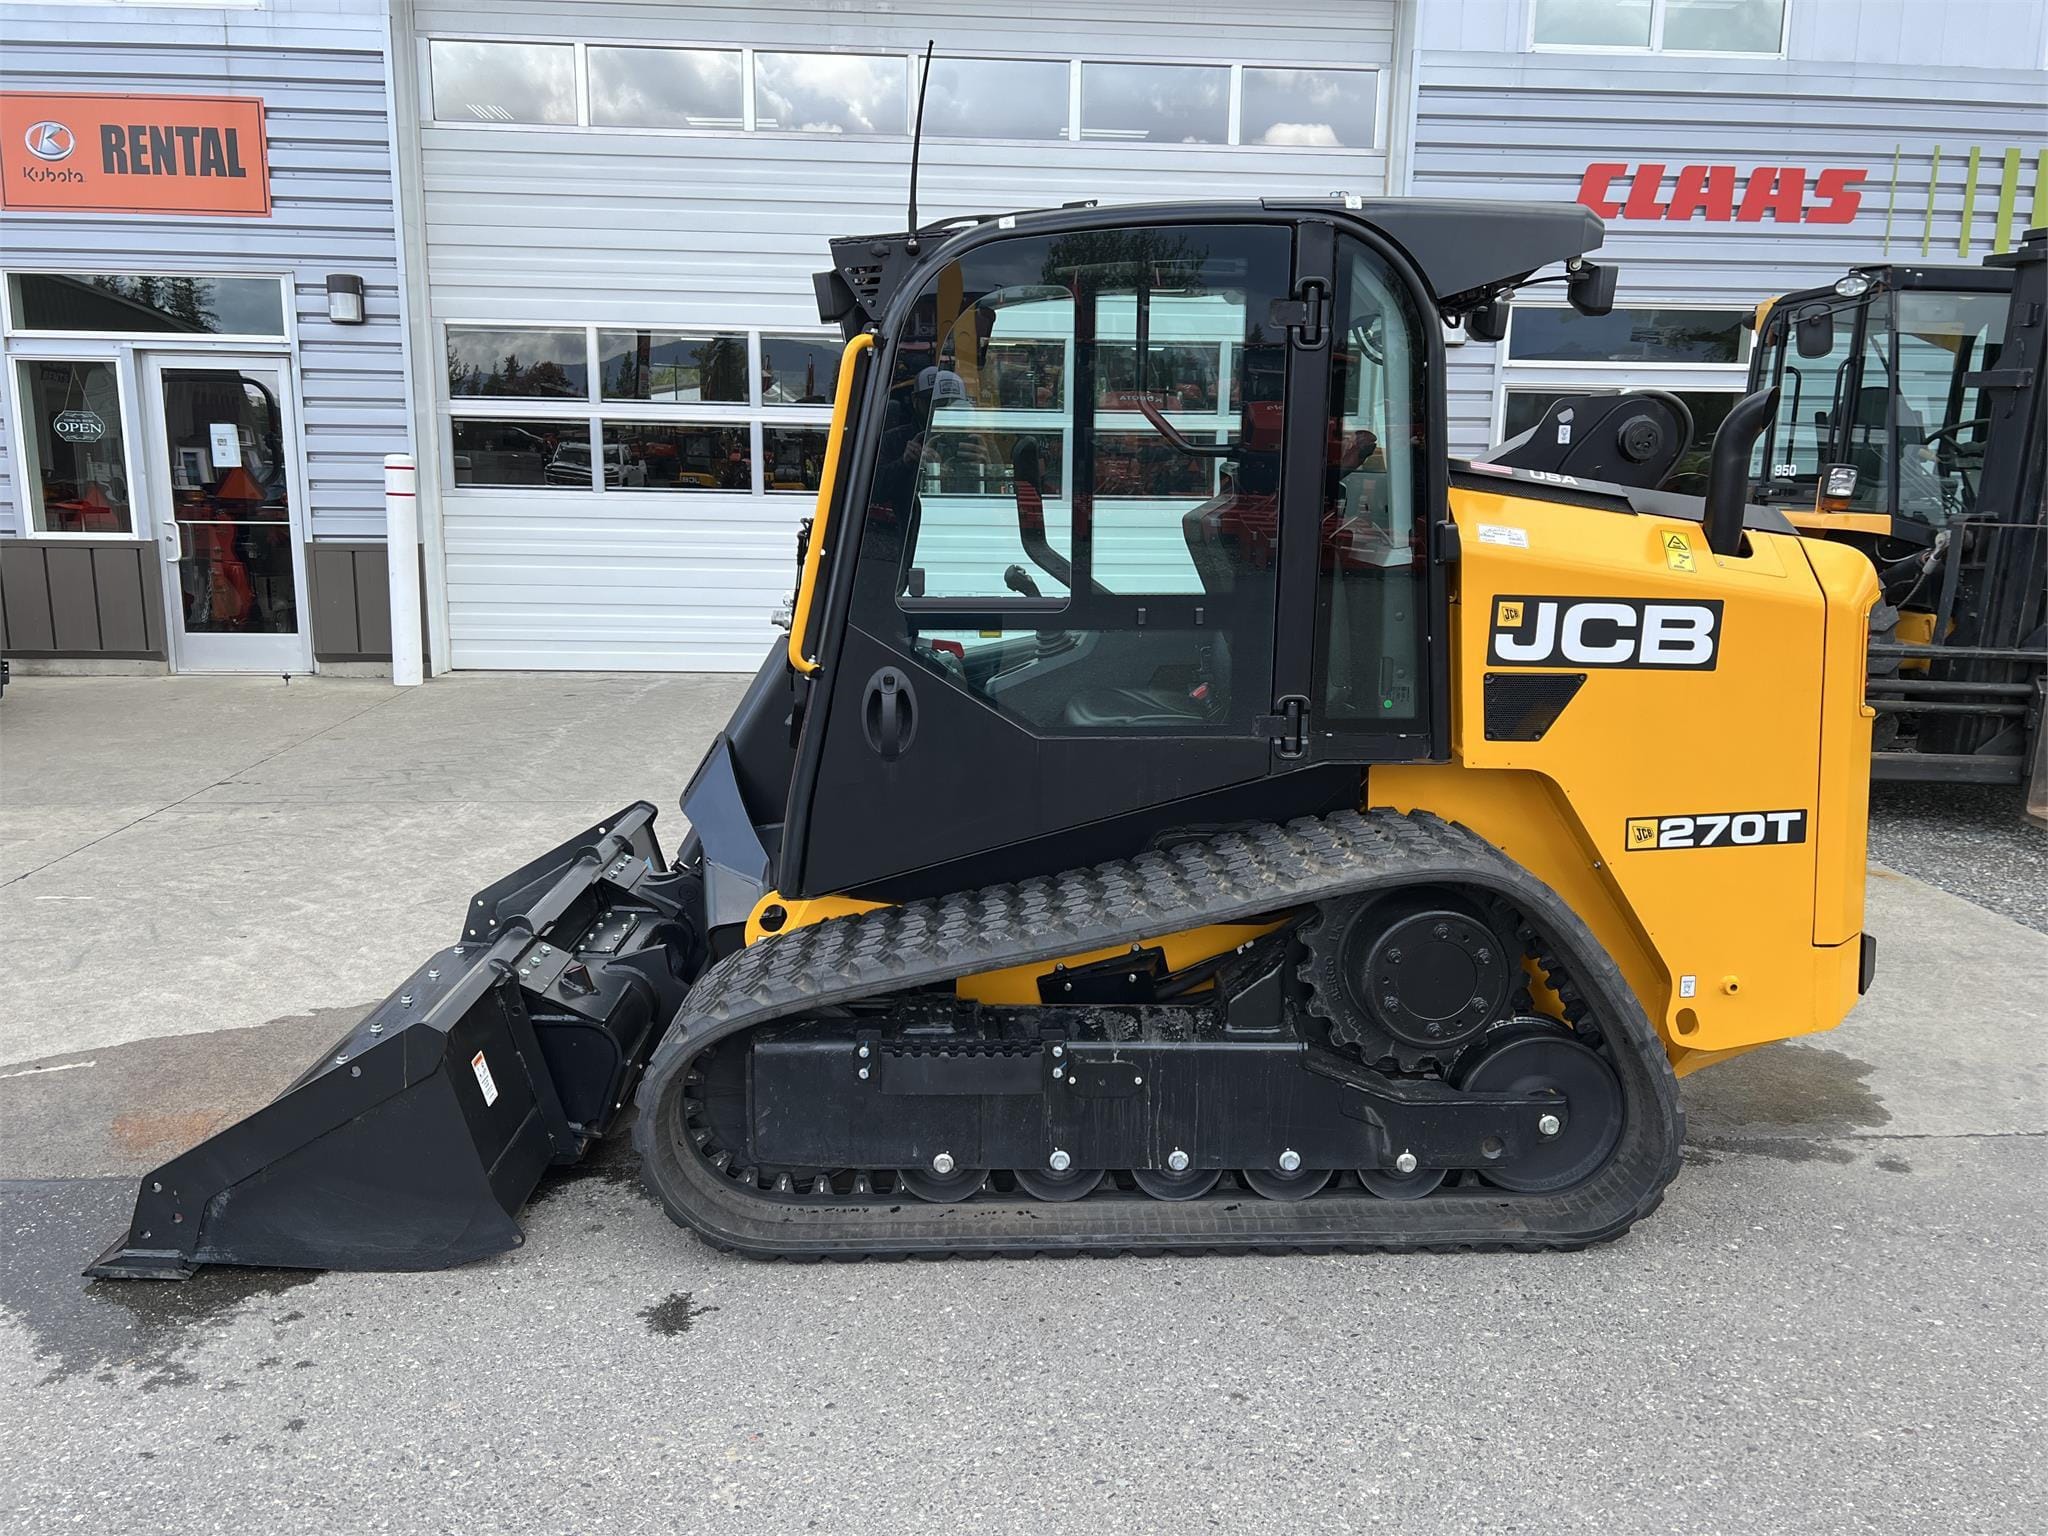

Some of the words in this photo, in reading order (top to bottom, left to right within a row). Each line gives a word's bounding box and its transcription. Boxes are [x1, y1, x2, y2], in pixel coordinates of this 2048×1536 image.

[100, 124, 247, 177] RENTAL
[23, 166, 84, 183] Kubota
[1576, 163, 1868, 224] CLAAS
[56, 422, 102, 433] OPEN
[1529, 470, 1578, 485] USA
[1774, 464, 1797, 477] 950
[1504, 608, 1519, 620] JCB
[1495, 602, 1715, 664] JCB
[1636, 827, 1653, 841] JCB
[1659, 812, 1801, 848] 270T
